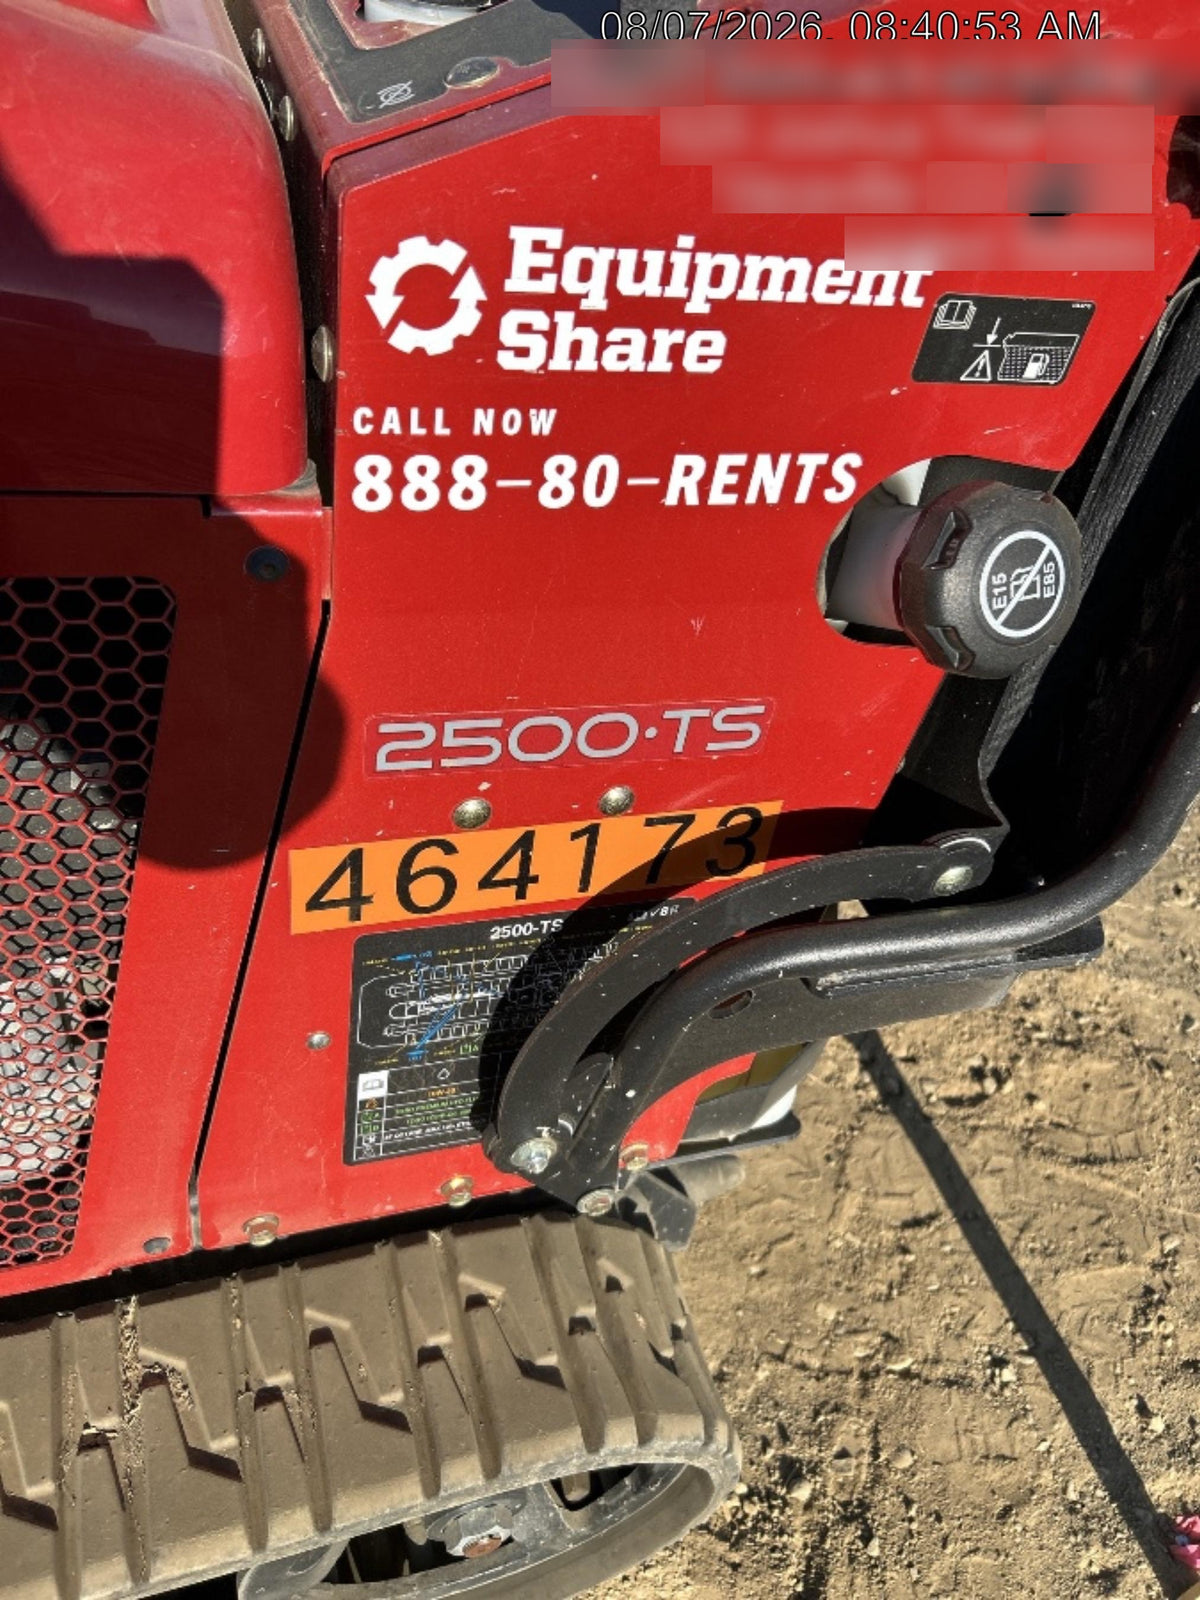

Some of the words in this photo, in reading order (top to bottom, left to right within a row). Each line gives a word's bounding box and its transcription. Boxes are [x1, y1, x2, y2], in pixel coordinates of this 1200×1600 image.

[504, 226, 933, 313] Equipment
[497, 310, 726, 373] Share
[353, 407, 451, 435] CALL
[474, 408, 557, 435] NOW
[352, 453, 863, 512] 888-80-RENTS
[992, 572, 1008, 611] E15
[1043, 561, 1055, 599] E85
[305, 806, 764, 922] 464173
[490, 919, 564, 941] 2500-TS
